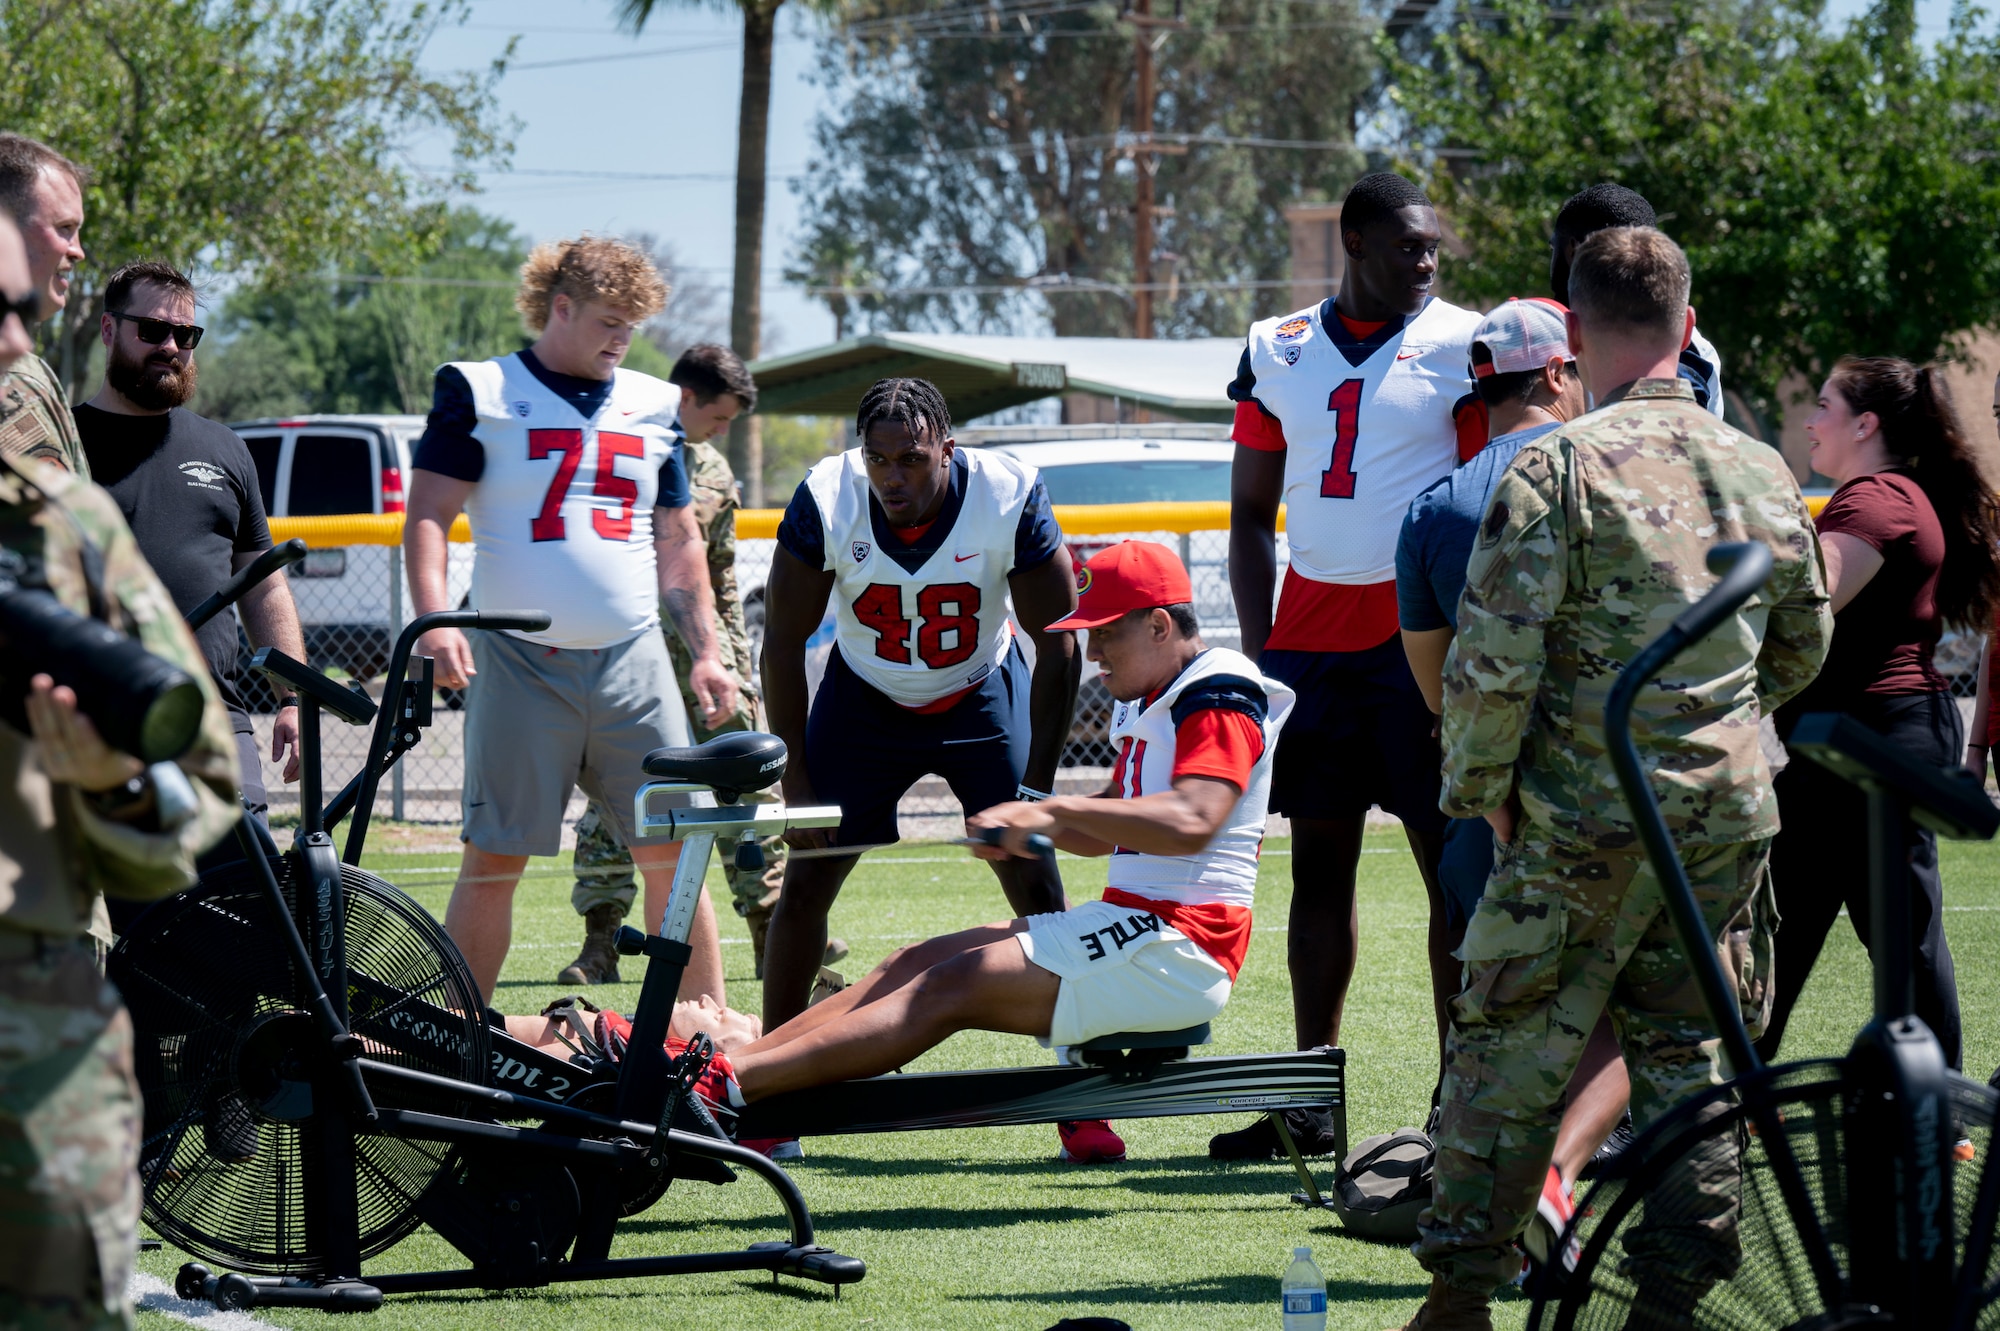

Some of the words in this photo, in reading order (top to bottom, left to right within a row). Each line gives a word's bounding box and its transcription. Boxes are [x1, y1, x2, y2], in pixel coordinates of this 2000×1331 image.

[1320, 378, 1365, 499] 1
[527, 428, 645, 542] 75
[852, 581, 982, 669] 48
[317, 878, 335, 979] ASSAULT
[1079, 912, 1173, 961] ATTLE
[546, 1075, 571, 1100] 2
[1230, 1097, 1261, 1105] concept
